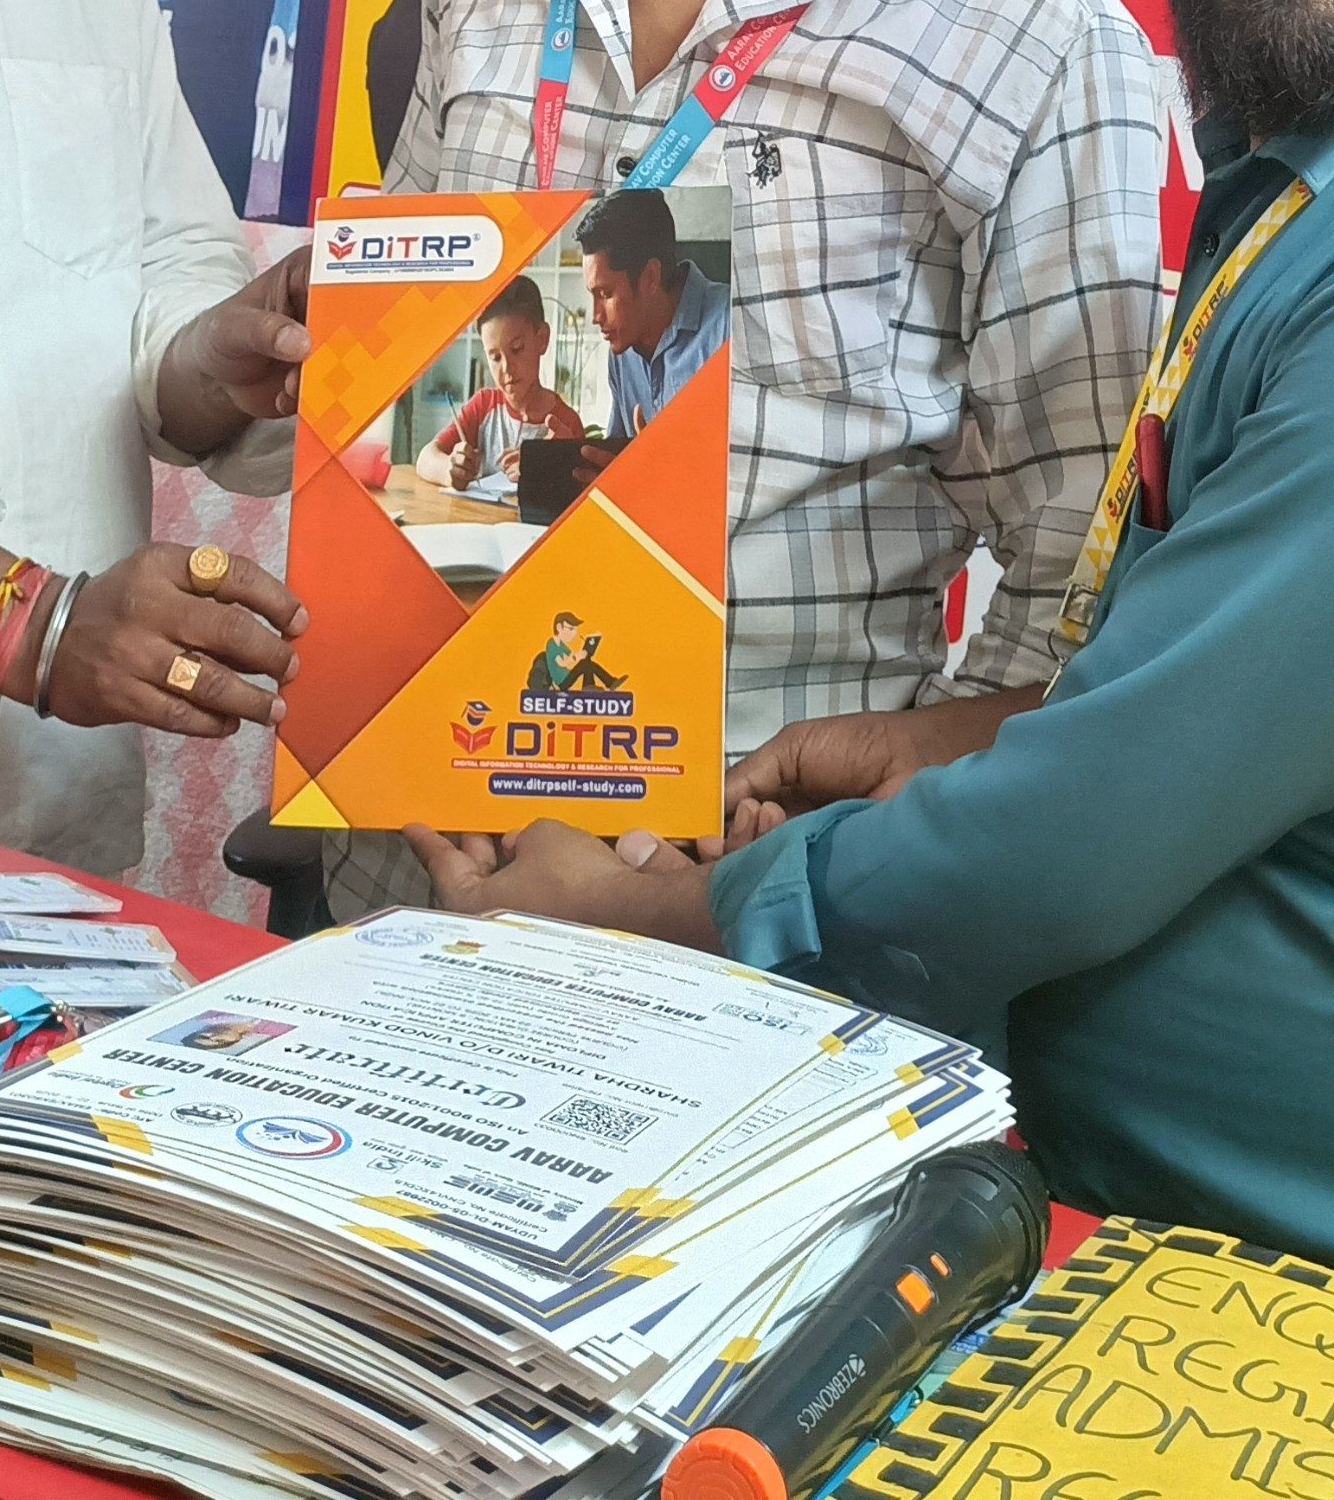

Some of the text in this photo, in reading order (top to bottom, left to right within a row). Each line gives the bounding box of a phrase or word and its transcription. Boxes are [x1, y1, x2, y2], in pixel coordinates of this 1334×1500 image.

[639, 128, 679, 176] COMPUTER
[663, 134, 692, 169] CENTER
[523, 697, 631, 714] SELF-STUDY
[479, 760, 524, 769] INFORMATION
[525, 762, 570, 770] TECHNOLOGY
[577, 764, 613, 772] RESEARCH
[629, 765, 680, 774] PROFESSIONAL
[493, 777, 643, 795] www.ditrpself-study.com
[418, 952, 478, 969] CENTER
[475, 963, 564, 987] EDUCATION
[224, 993, 296, 1012] TIWARI
[560, 982, 653, 1008] COMPUTER
[304, 1005, 379, 1027] KUMAR
[357, 999, 448, 1022] APPLICATION
[648, 1003, 709, 1021] AARAV
[384, 1023, 453, 1044] VINOD
[446, 1018, 527, 1040] COMPUTER
[102, 1047, 205, 1075] CENTER
[459, 1040, 504, 1060] D/O
[540, 1040, 610, 1059] DIPLOMA
[283, 1042, 527, 1111] Certificate
[507, 1052, 586, 1078] TIWARI
[213, 1067, 355, 1110] EDUCATION
[225, 1056, 529, 1137] An ISO 9001:2015 Certified Organization
[594, 1072, 702, 1109] SHARDHA
[356, 1098, 509, 1153] COMPUTER
[363, 1140, 444, 1170] Skill India
[510, 1146, 613, 1185] AARAV
[796, 1363, 867, 1434] ZEBRONICS
